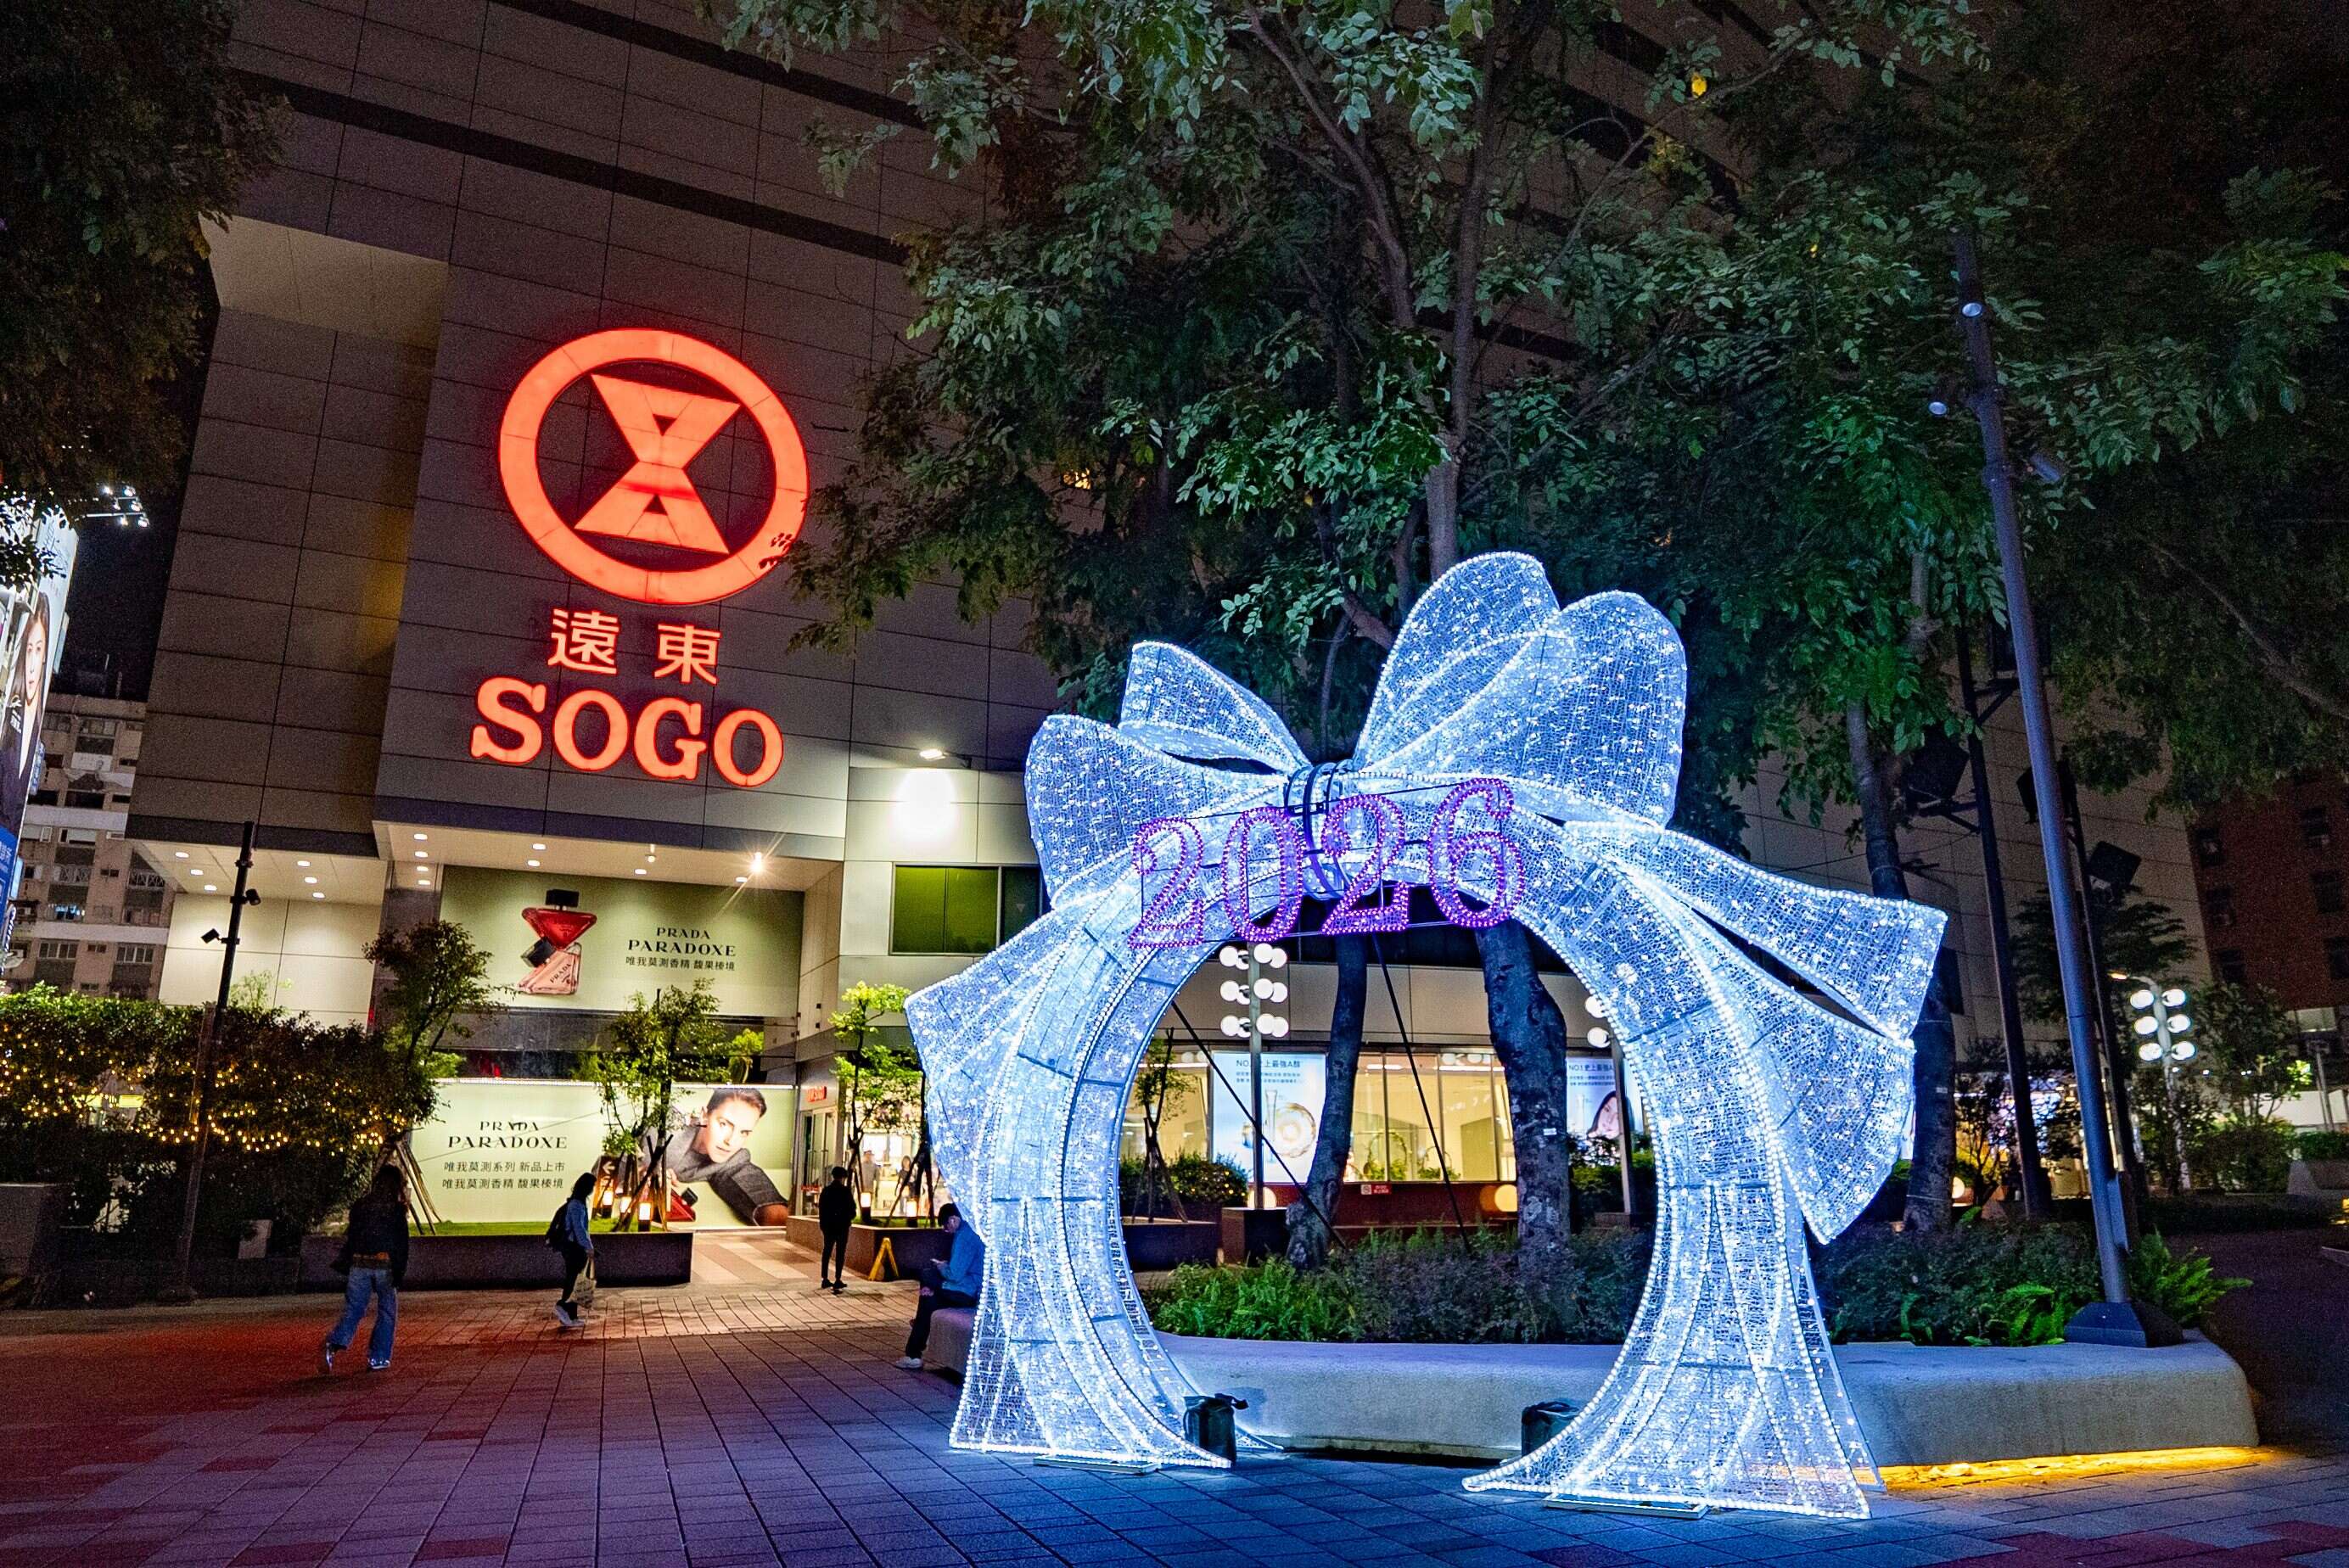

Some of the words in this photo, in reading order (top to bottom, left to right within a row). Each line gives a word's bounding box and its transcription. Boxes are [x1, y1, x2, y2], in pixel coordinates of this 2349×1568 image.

[547, 608, 721, 686] 遠東
[470, 677, 784, 787] SOGO
[1128, 777, 1525, 948] 2026
[656, 927, 711, 940] PRADA
[628, 939, 737, 957] PARADOXE
[550, 963, 571, 983] PRADA
[479, 1121, 540, 1131] PRADA
[448, 1136, 568, 1149] PARADOXE
[444, 1162, 516, 1173] 唯我莫測系列
[519, 1162, 565, 1173] 新品上市
[442, 1179, 514, 1190] 唯我莫測香精
